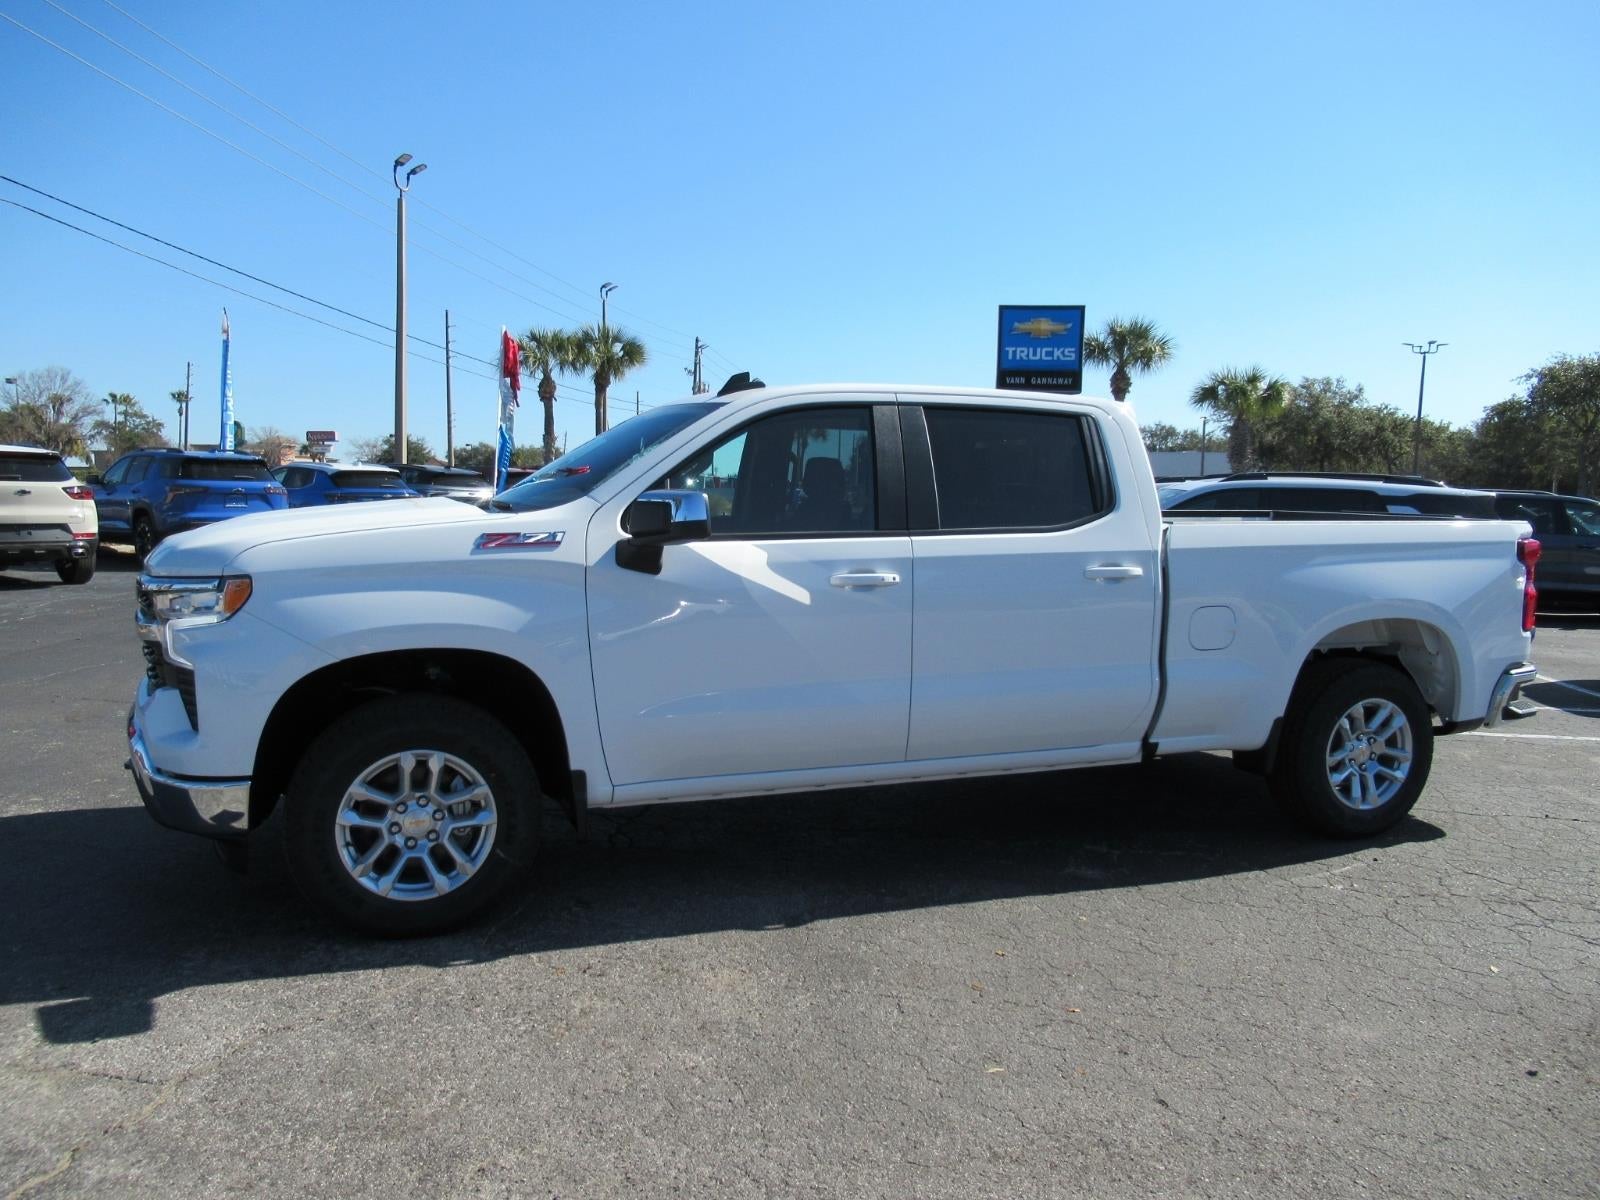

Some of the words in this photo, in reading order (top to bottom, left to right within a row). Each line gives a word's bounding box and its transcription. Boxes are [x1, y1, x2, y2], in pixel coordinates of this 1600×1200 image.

[1005, 346, 1076, 361] TRUCKS
[1006, 376, 1025, 385] VANN
[1031, 376, 1073, 385] GANNAWAY
[480, 531, 566, 549] Z71
